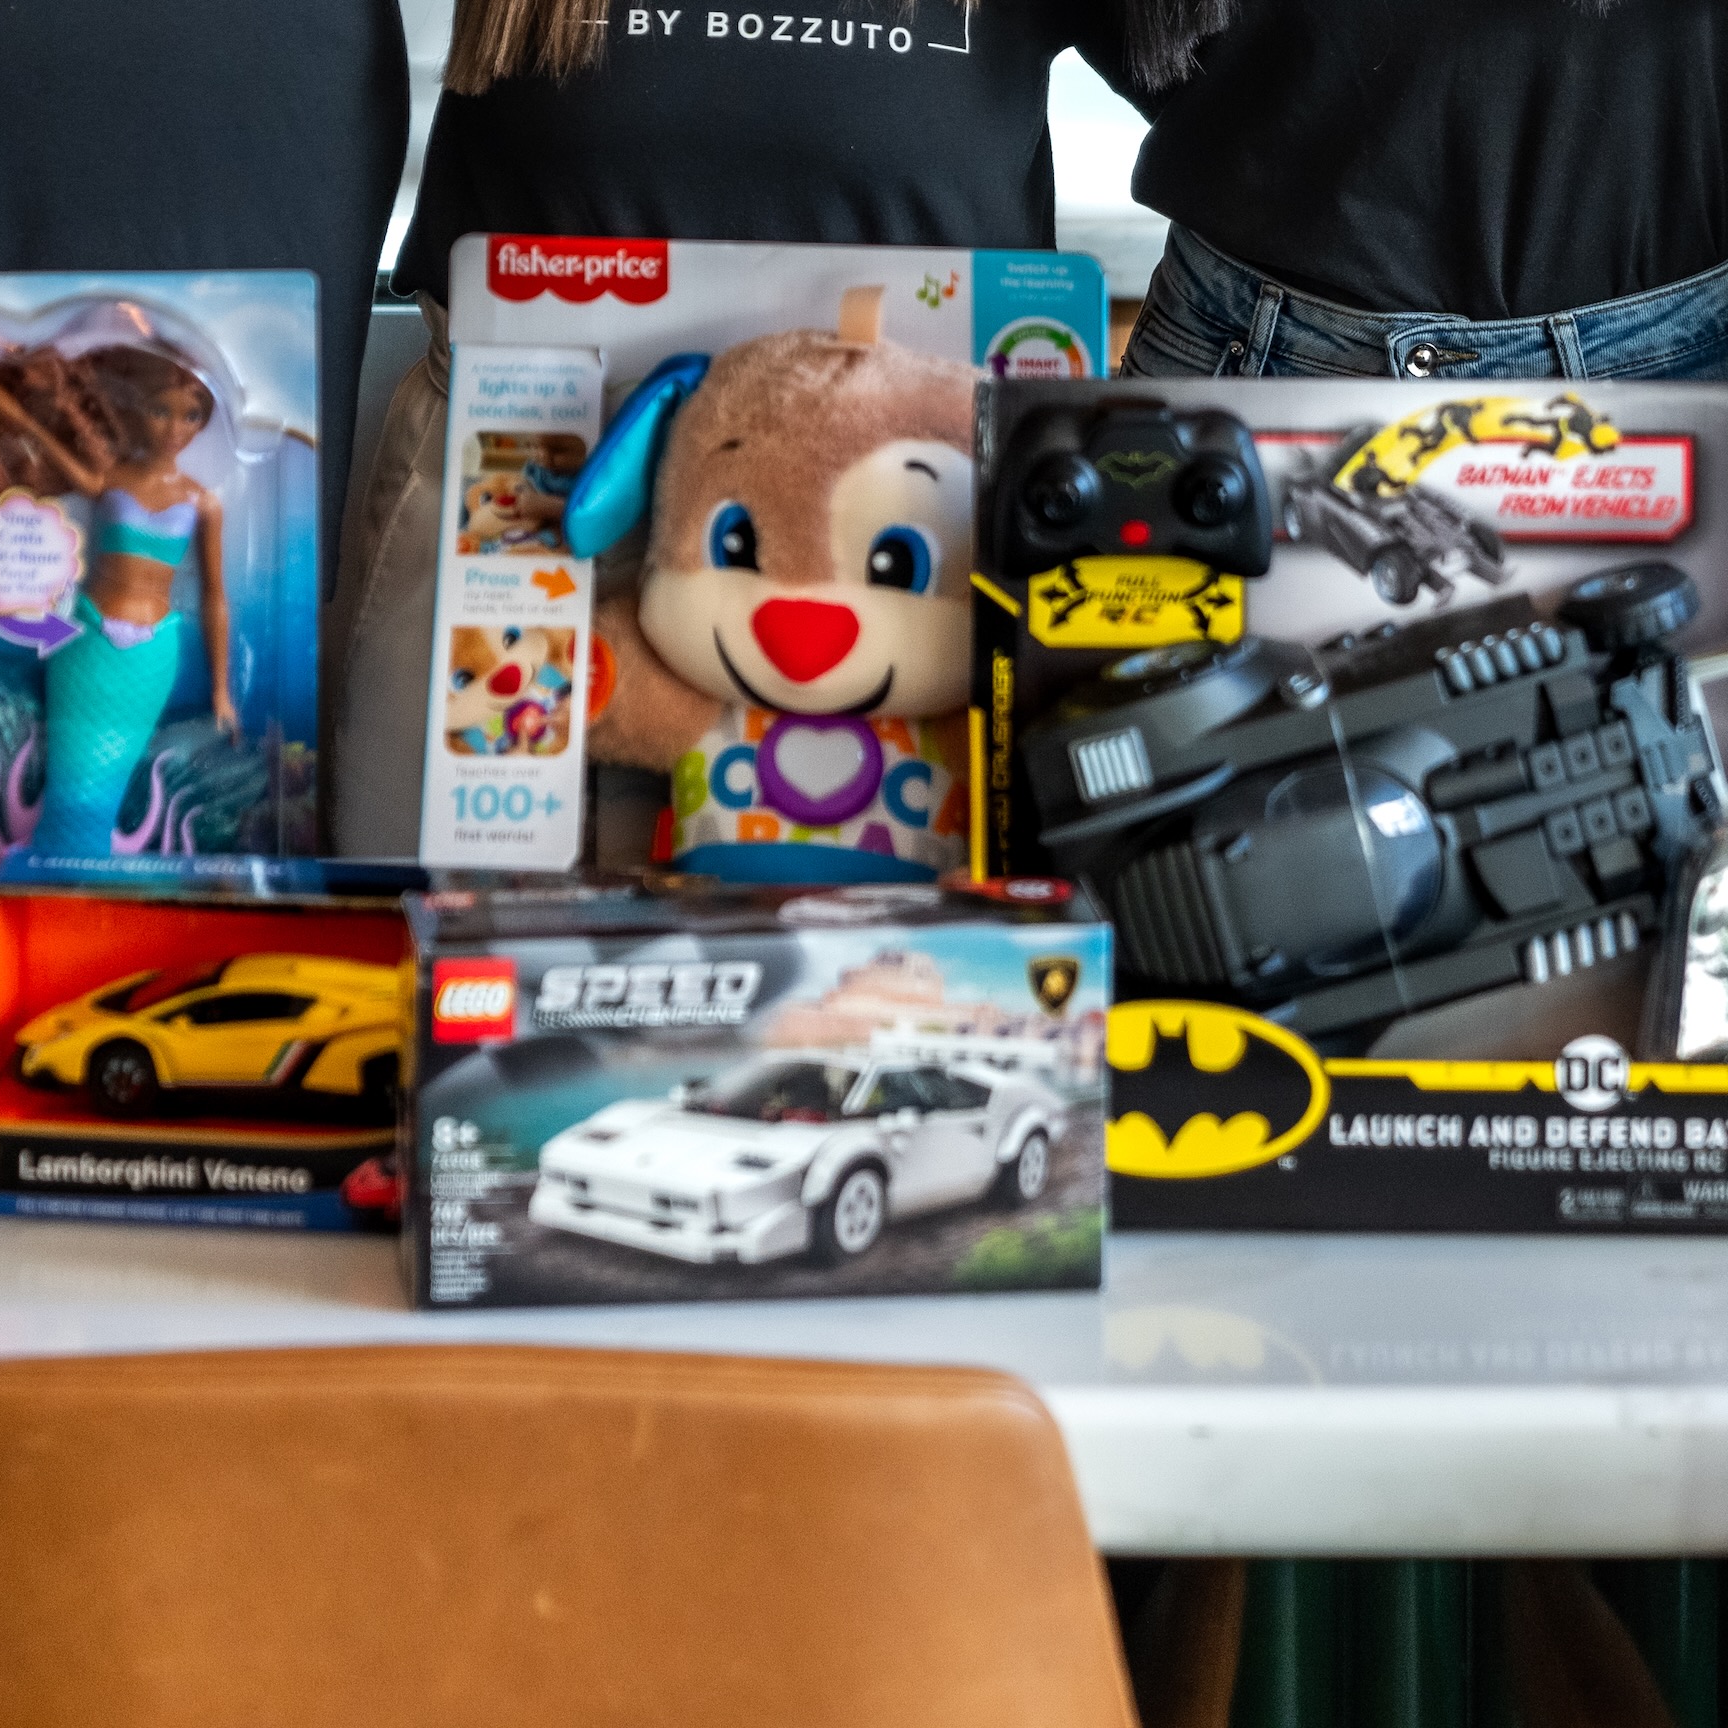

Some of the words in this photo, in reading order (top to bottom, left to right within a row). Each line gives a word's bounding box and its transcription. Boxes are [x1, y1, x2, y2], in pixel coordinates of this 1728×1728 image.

[627, 9, 681, 36] BY
[707, 11, 913, 53] BOZZUTO
[497, 242, 661, 286] fisher-price
[1571, 464, 1656, 490] EJECTS
[1498, 493, 1566, 518] FROM
[452, 783, 564, 822] 100+
[536, 960, 763, 1012] SPEED
[1562, 1053, 1624, 1094] DC
[1329, 1112, 1463, 1147] LAUNCH
[1468, 1113, 1538, 1148] AND
[1544, 1115, 1678, 1150] DEFEND
[18, 1148, 199, 1192] Lamborghini
[202, 1157, 313, 1195] Veneno
[1488, 1147, 1573, 1172] FIGURE
[1578, 1148, 1690, 1173] EJECTING
[1693, 1150, 1725, 1173] RC
